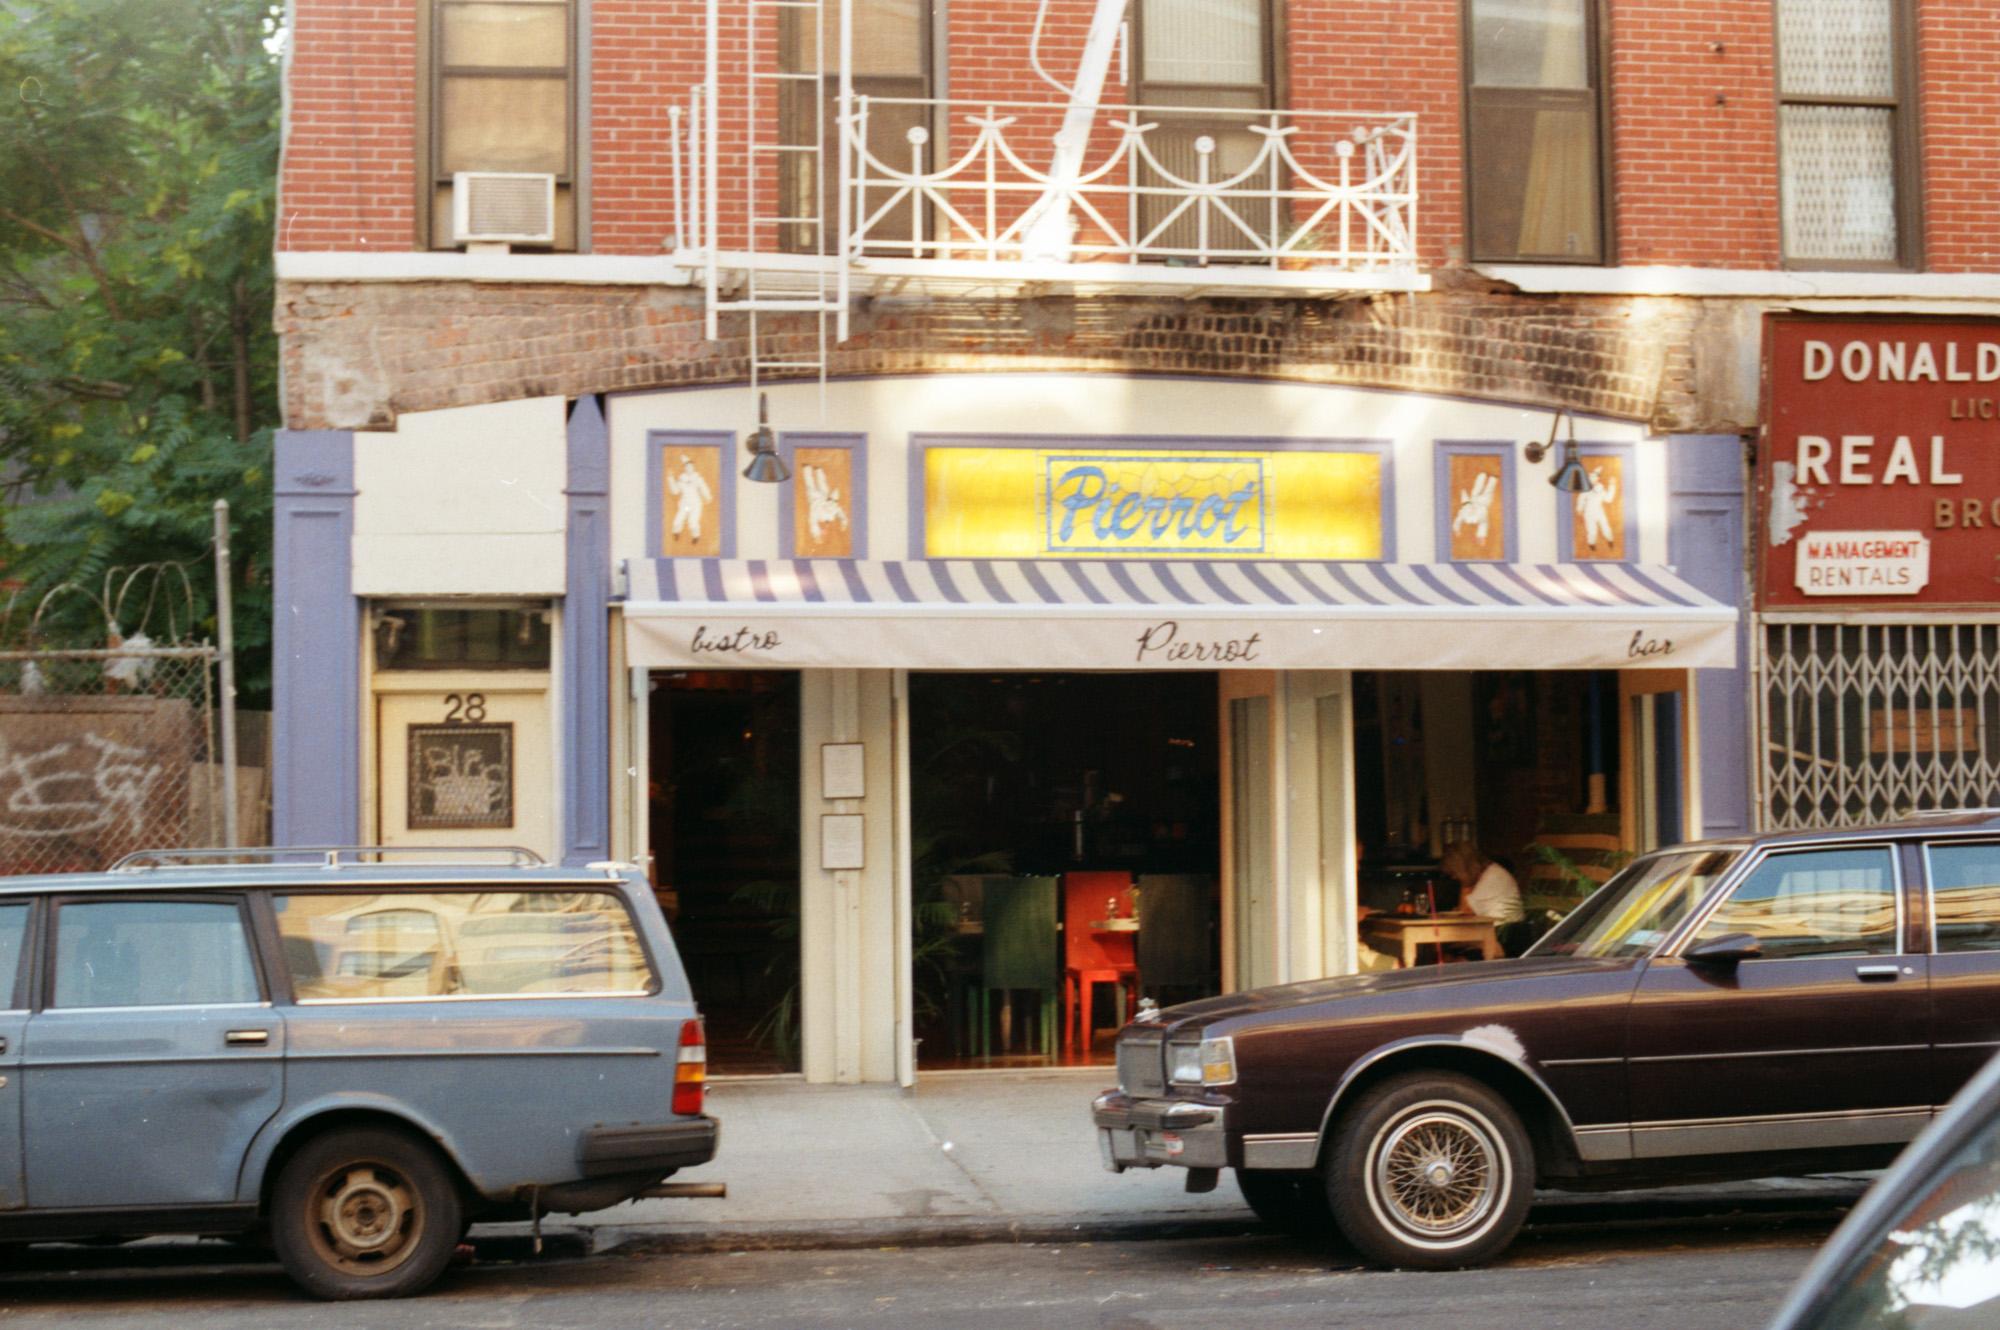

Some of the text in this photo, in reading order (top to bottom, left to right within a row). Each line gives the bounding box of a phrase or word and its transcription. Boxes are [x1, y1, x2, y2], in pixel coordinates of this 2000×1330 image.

[1803, 340, 2000, 382] DONALD
[1951, 398, 2000, 418] LIC
[1797, 435, 1963, 485] REAL
[1058, 465, 1261, 543] Pierrot
[1808, 541, 1920, 559] MANAGEMENT
[1809, 566, 1911, 587] RENTALS
[691, 625, 782, 652] bistro
[1137, 621, 1260, 662] Pierrot
[1628, 630, 1675, 657] bar
[444, 693, 486, 722] 28
